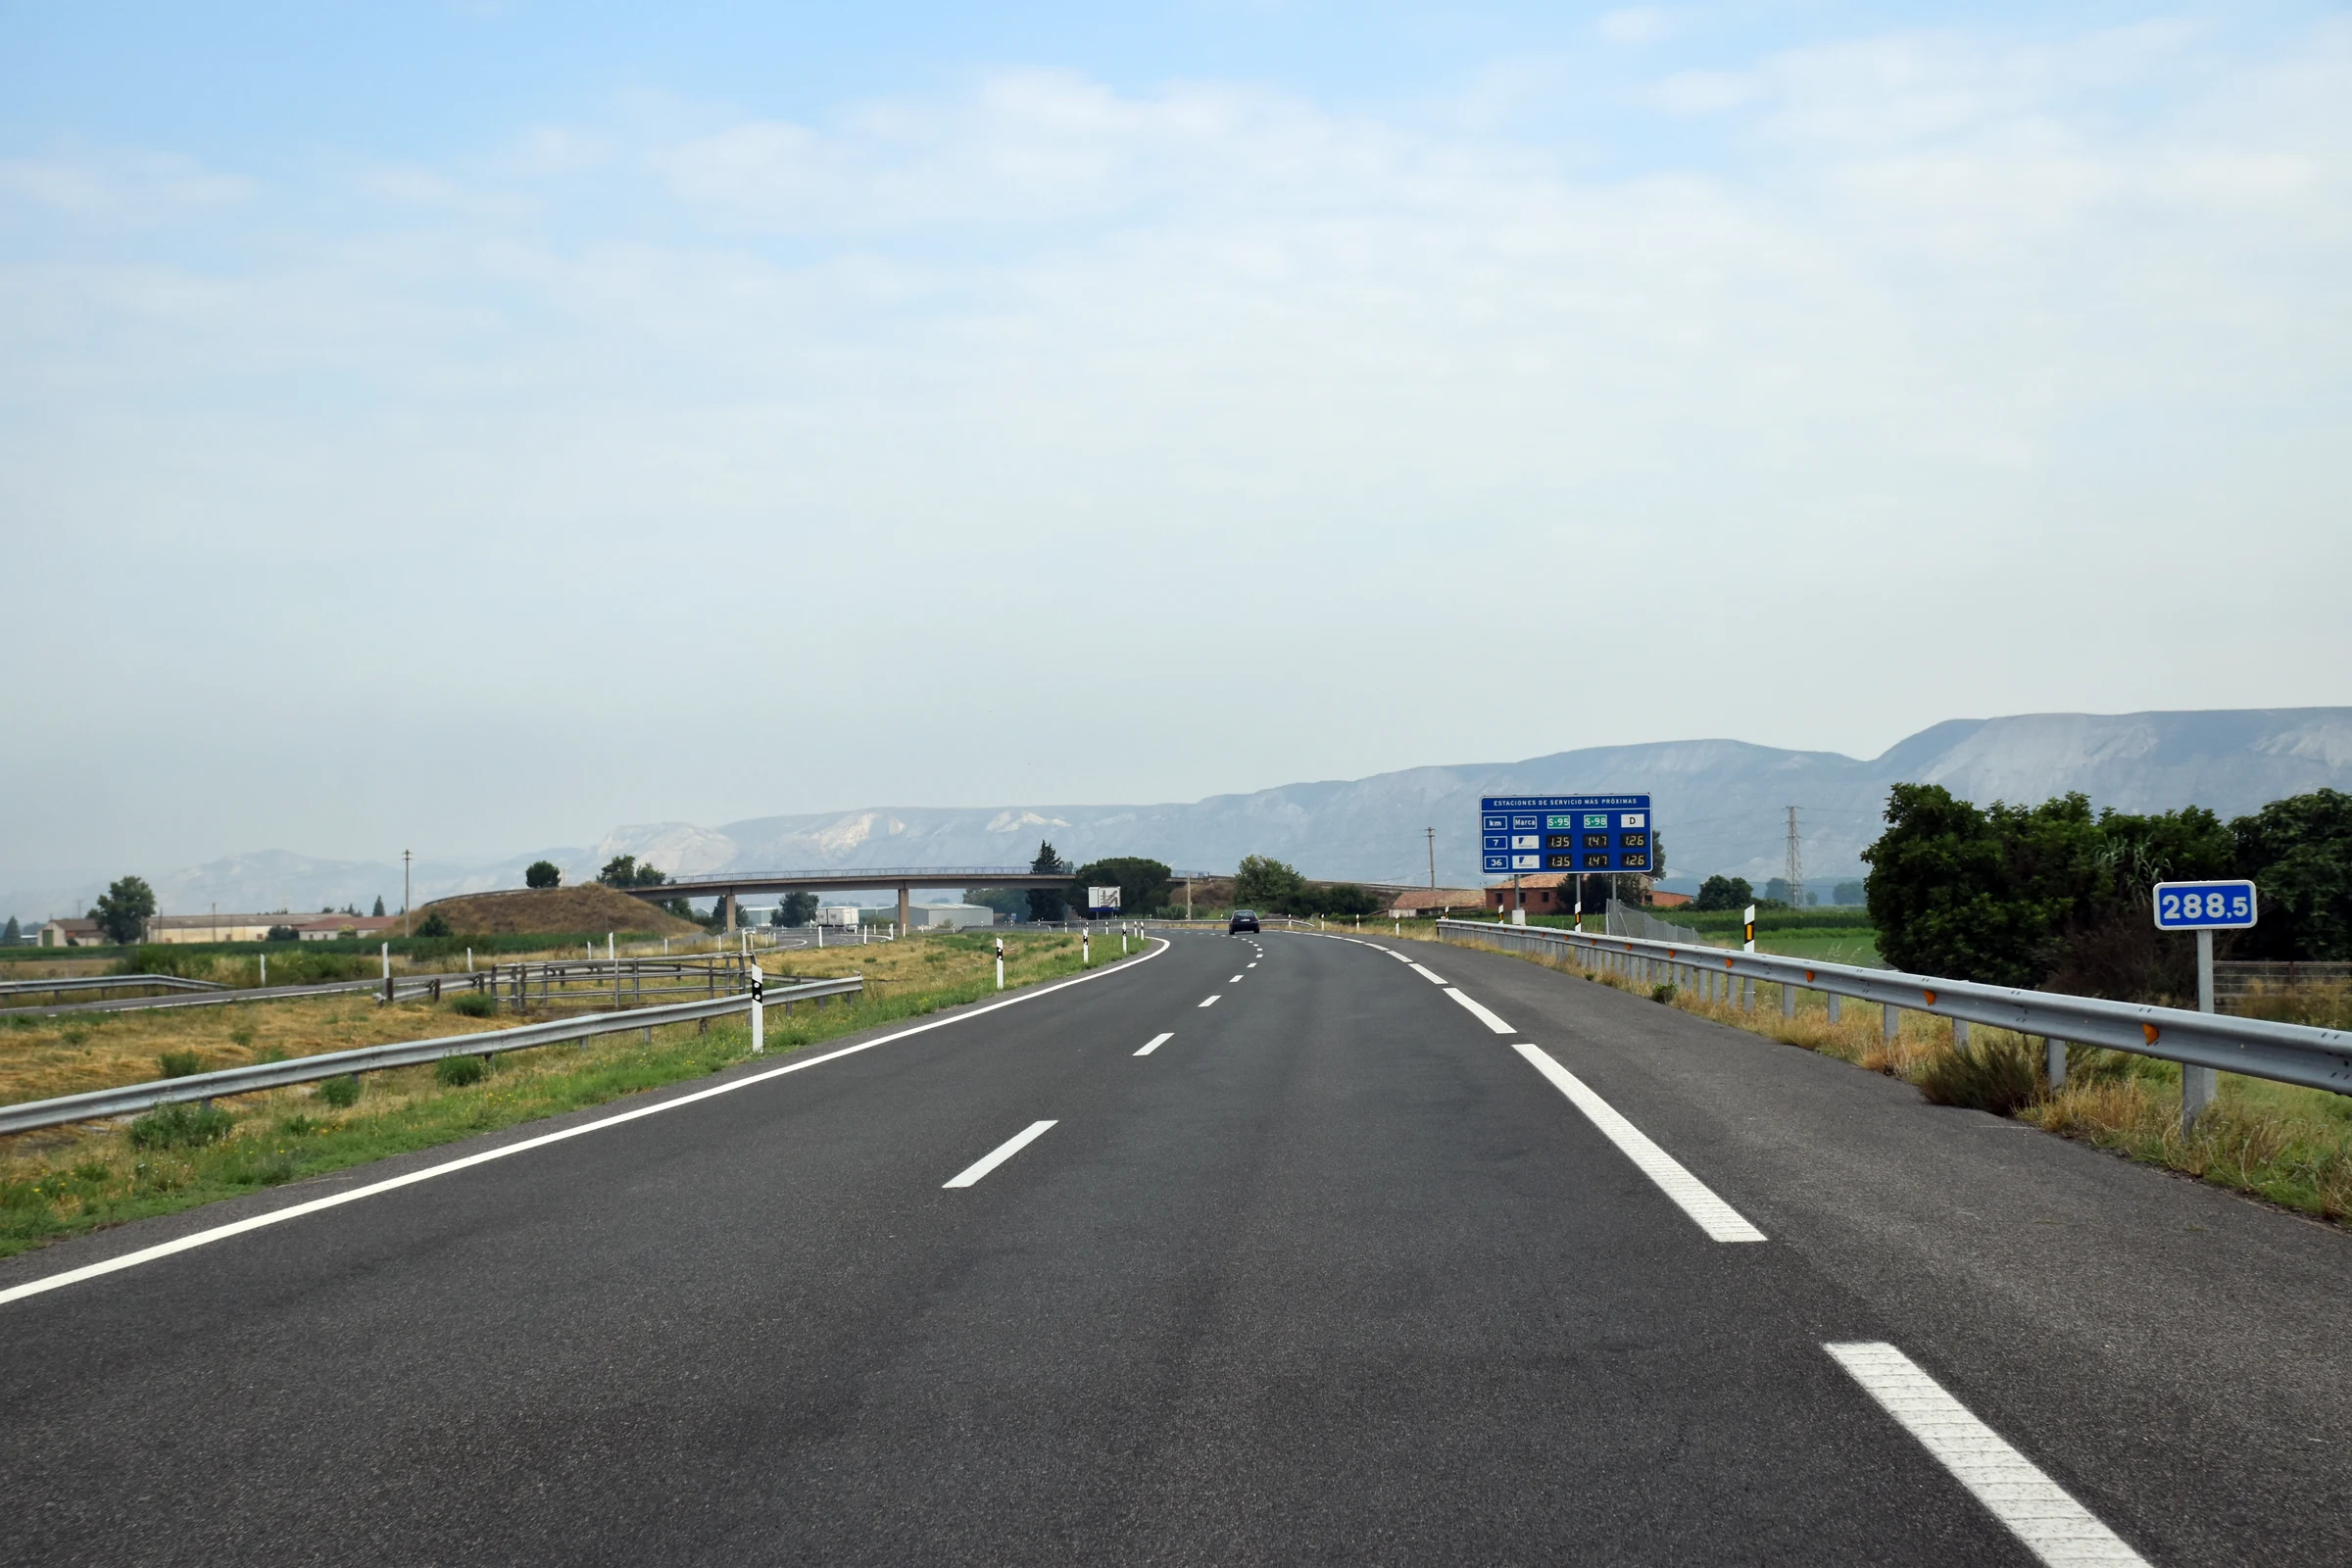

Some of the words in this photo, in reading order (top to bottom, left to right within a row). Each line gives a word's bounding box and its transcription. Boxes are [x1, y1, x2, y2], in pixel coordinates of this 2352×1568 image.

[1547, 817, 1570, 826] S-95
[1585, 817, 1607, 826] S-98
[1629, 816, 1637, 825] D
[1491, 858, 1502, 867] 36
[2162, 893, 2249, 919] 288,5
